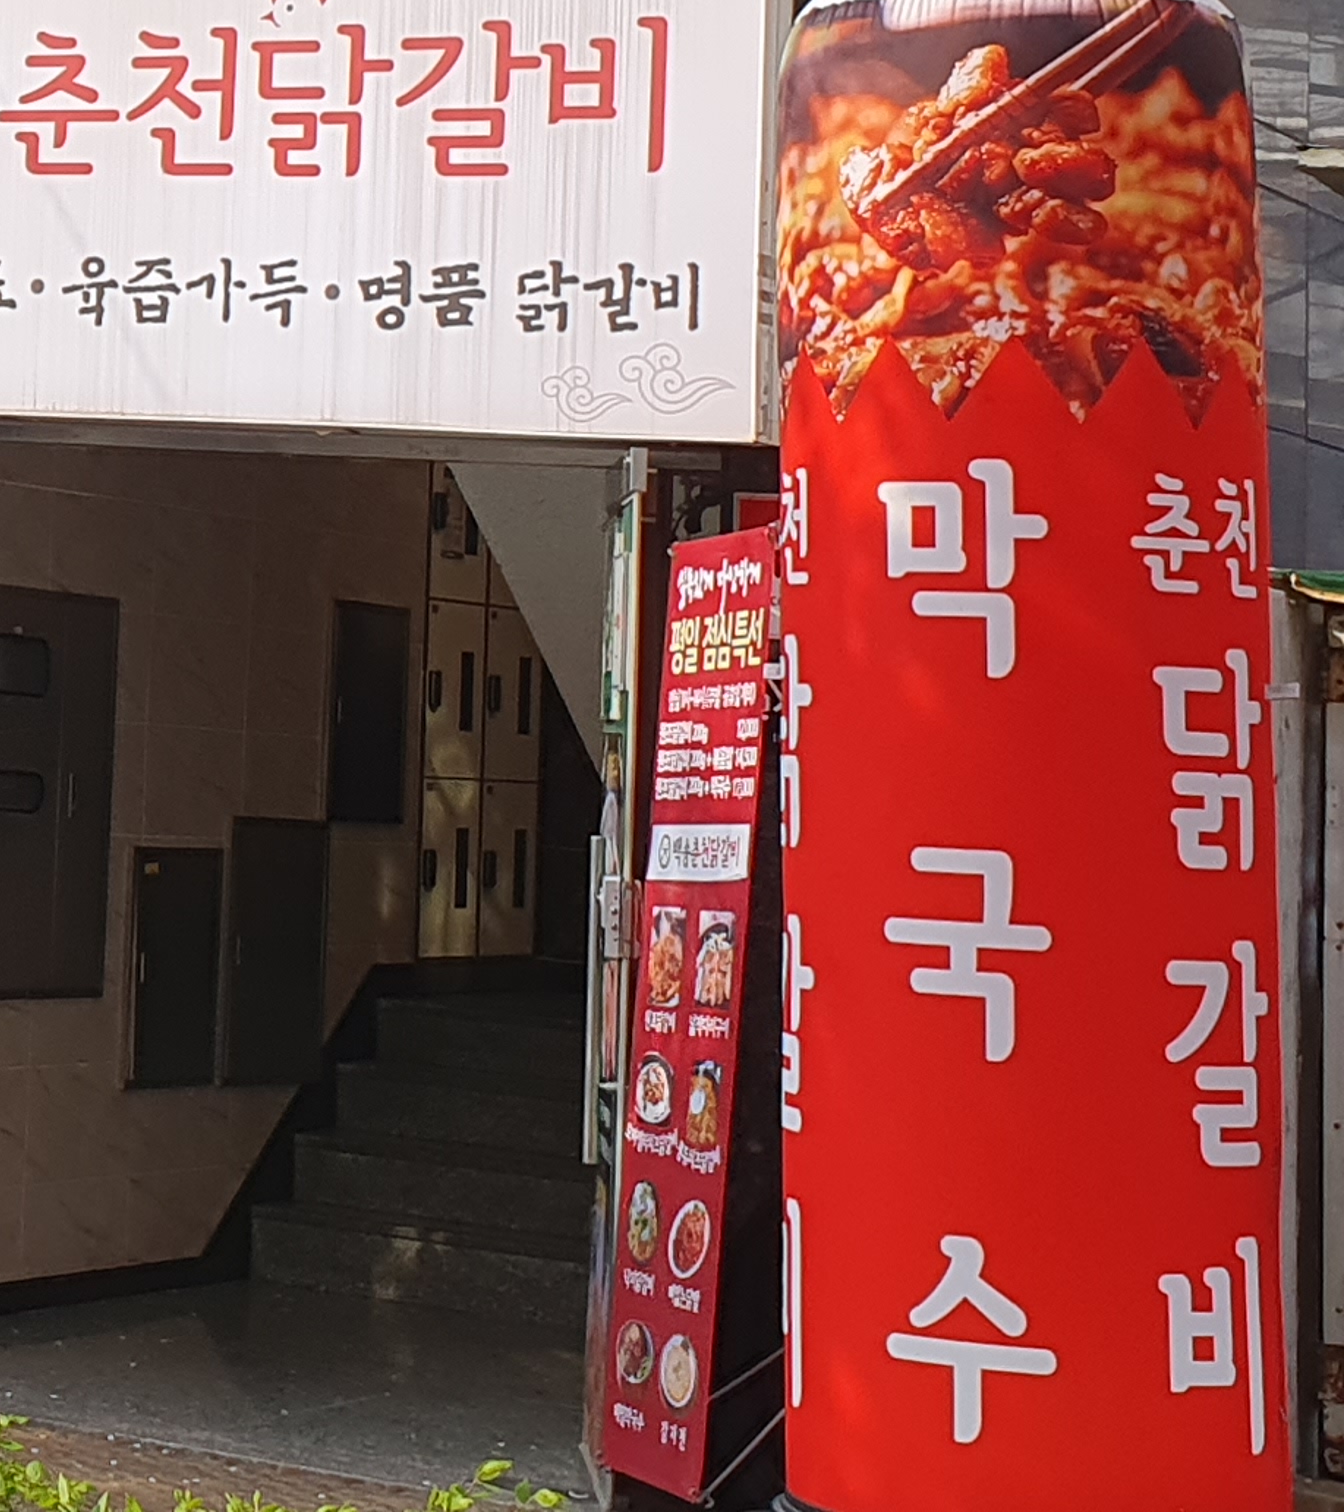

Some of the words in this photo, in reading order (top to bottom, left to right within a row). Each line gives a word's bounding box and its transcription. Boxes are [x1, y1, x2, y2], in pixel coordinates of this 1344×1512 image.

[515, 258, 703, 333] 닭갈비
[1130, 472, 1257, 600] 춘천
[668, 615, 701, 675] 평일
[702, 607, 765, 671] 점심특선
[877, 457, 1059, 1445] 막국수
